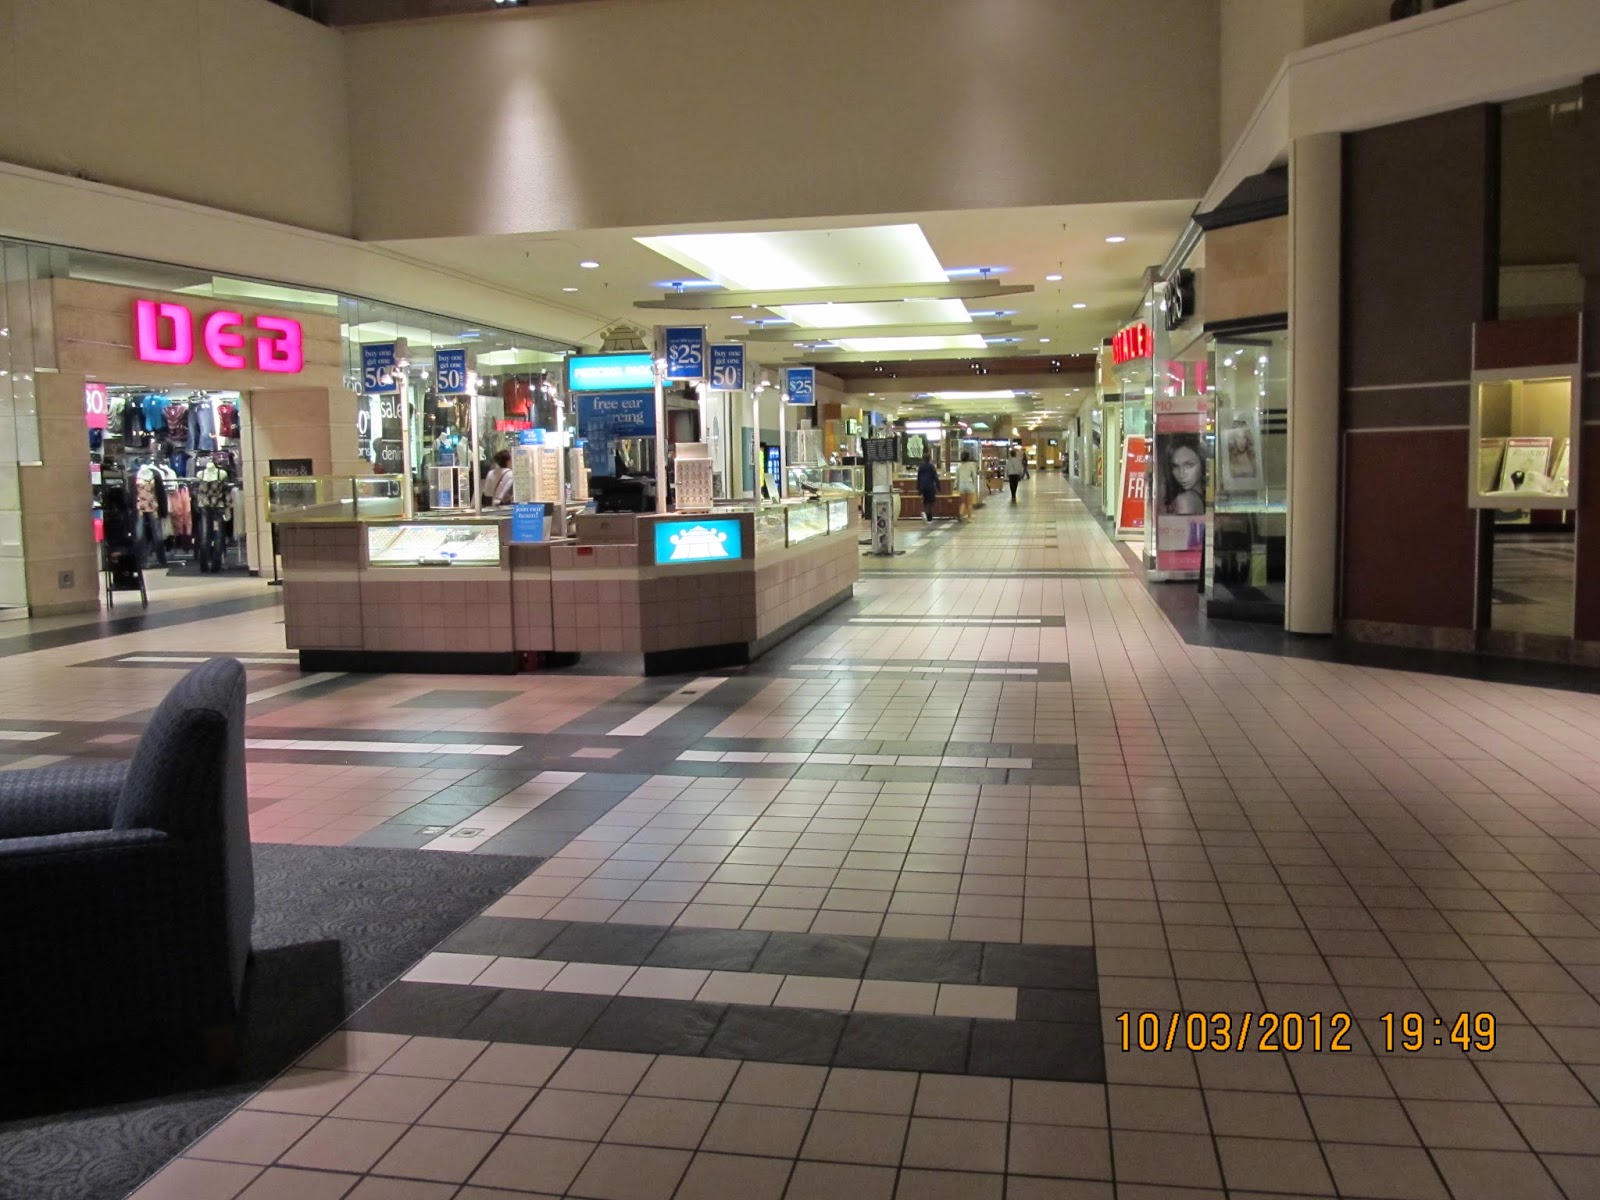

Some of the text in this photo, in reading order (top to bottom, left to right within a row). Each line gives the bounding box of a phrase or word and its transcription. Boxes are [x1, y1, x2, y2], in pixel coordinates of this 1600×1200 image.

[136, 299, 303, 374] DEB
[669, 344, 702, 364] $25
[438, 370, 460, 389] 50
[713, 366, 737, 385] 50
[790, 380, 812, 394] $25
[593, 397, 643, 409] free ear
[300, 466, 308, 476] &
